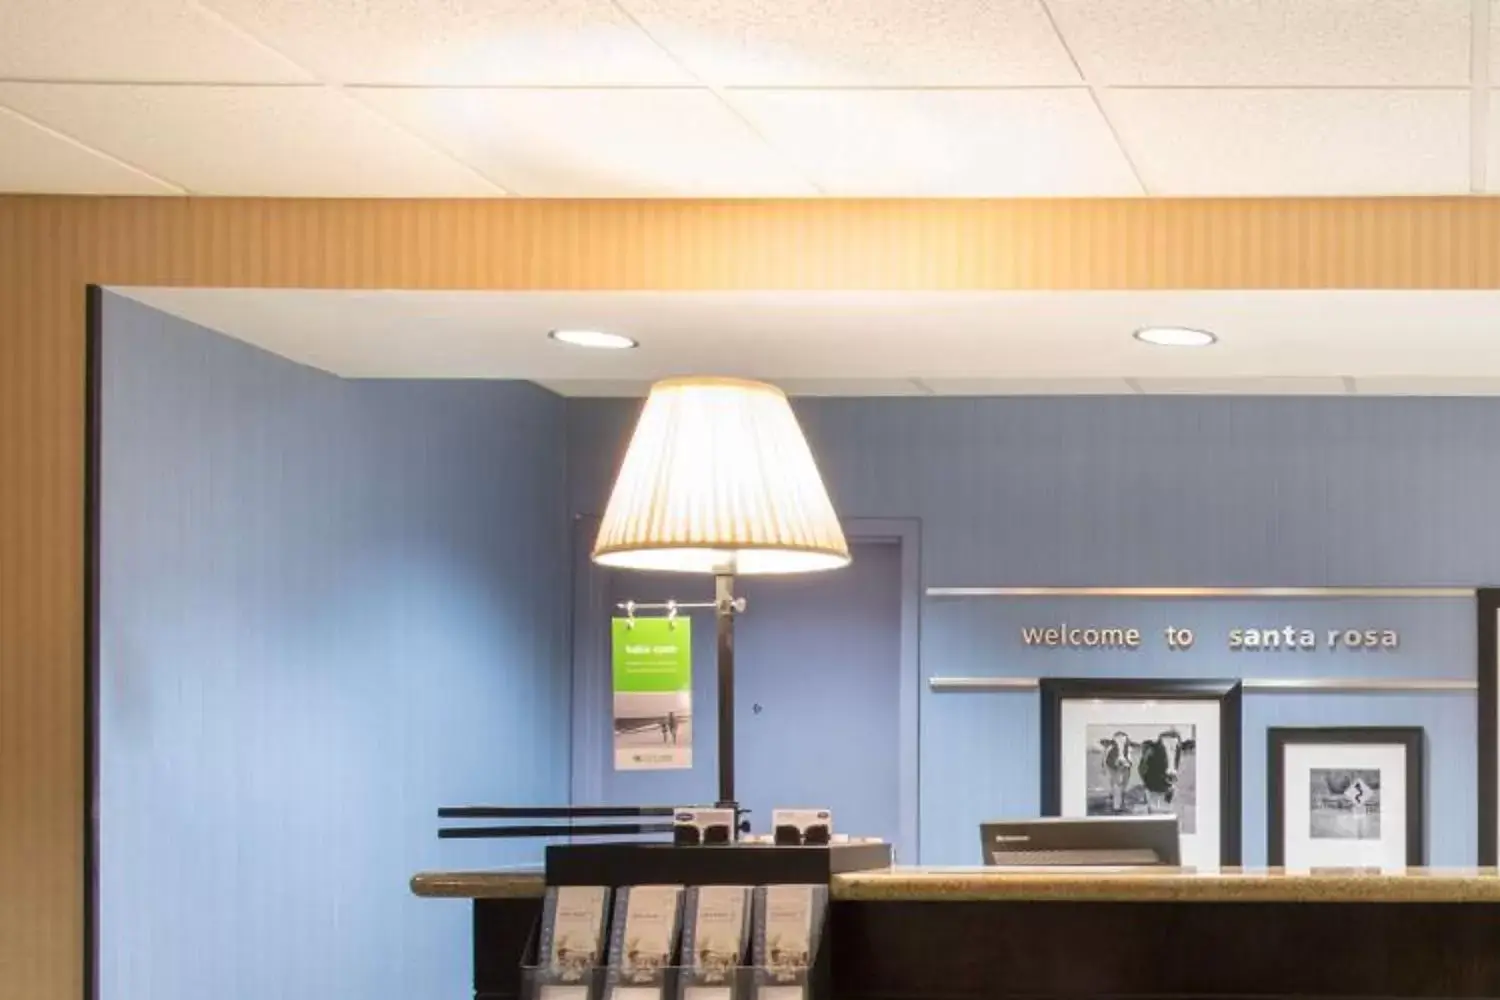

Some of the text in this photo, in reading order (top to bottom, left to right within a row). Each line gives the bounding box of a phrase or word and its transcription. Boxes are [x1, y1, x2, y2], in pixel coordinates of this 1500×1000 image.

[1021, 623, 1399, 648] welcome to santa rosa
